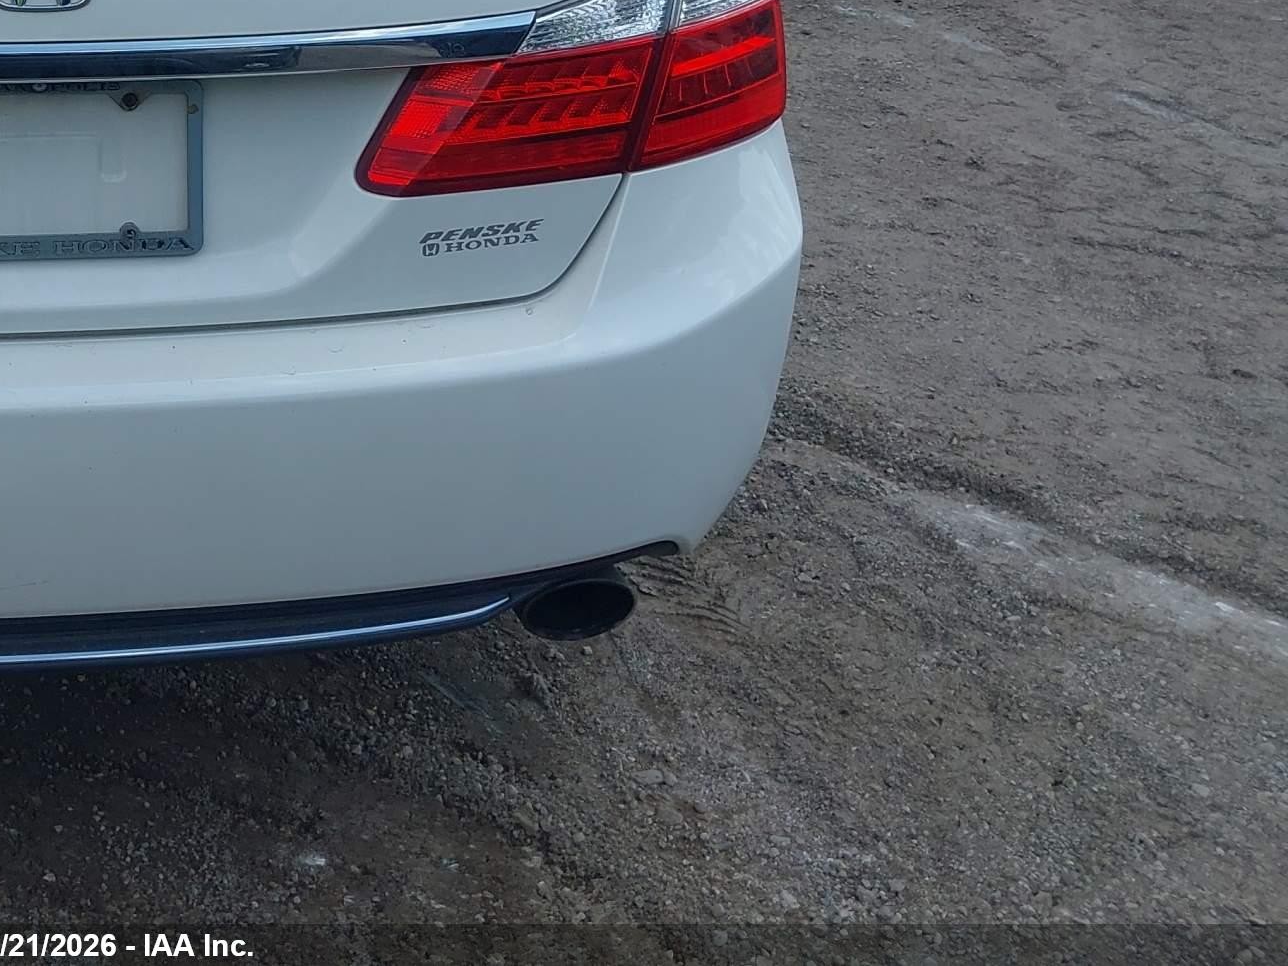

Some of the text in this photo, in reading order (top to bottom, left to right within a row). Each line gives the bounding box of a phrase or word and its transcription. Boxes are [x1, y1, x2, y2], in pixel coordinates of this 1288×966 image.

[419, 218, 544, 244] PENSKE
[52, 237, 195, 256] HONDA
[444, 233, 539, 253] HONDA
